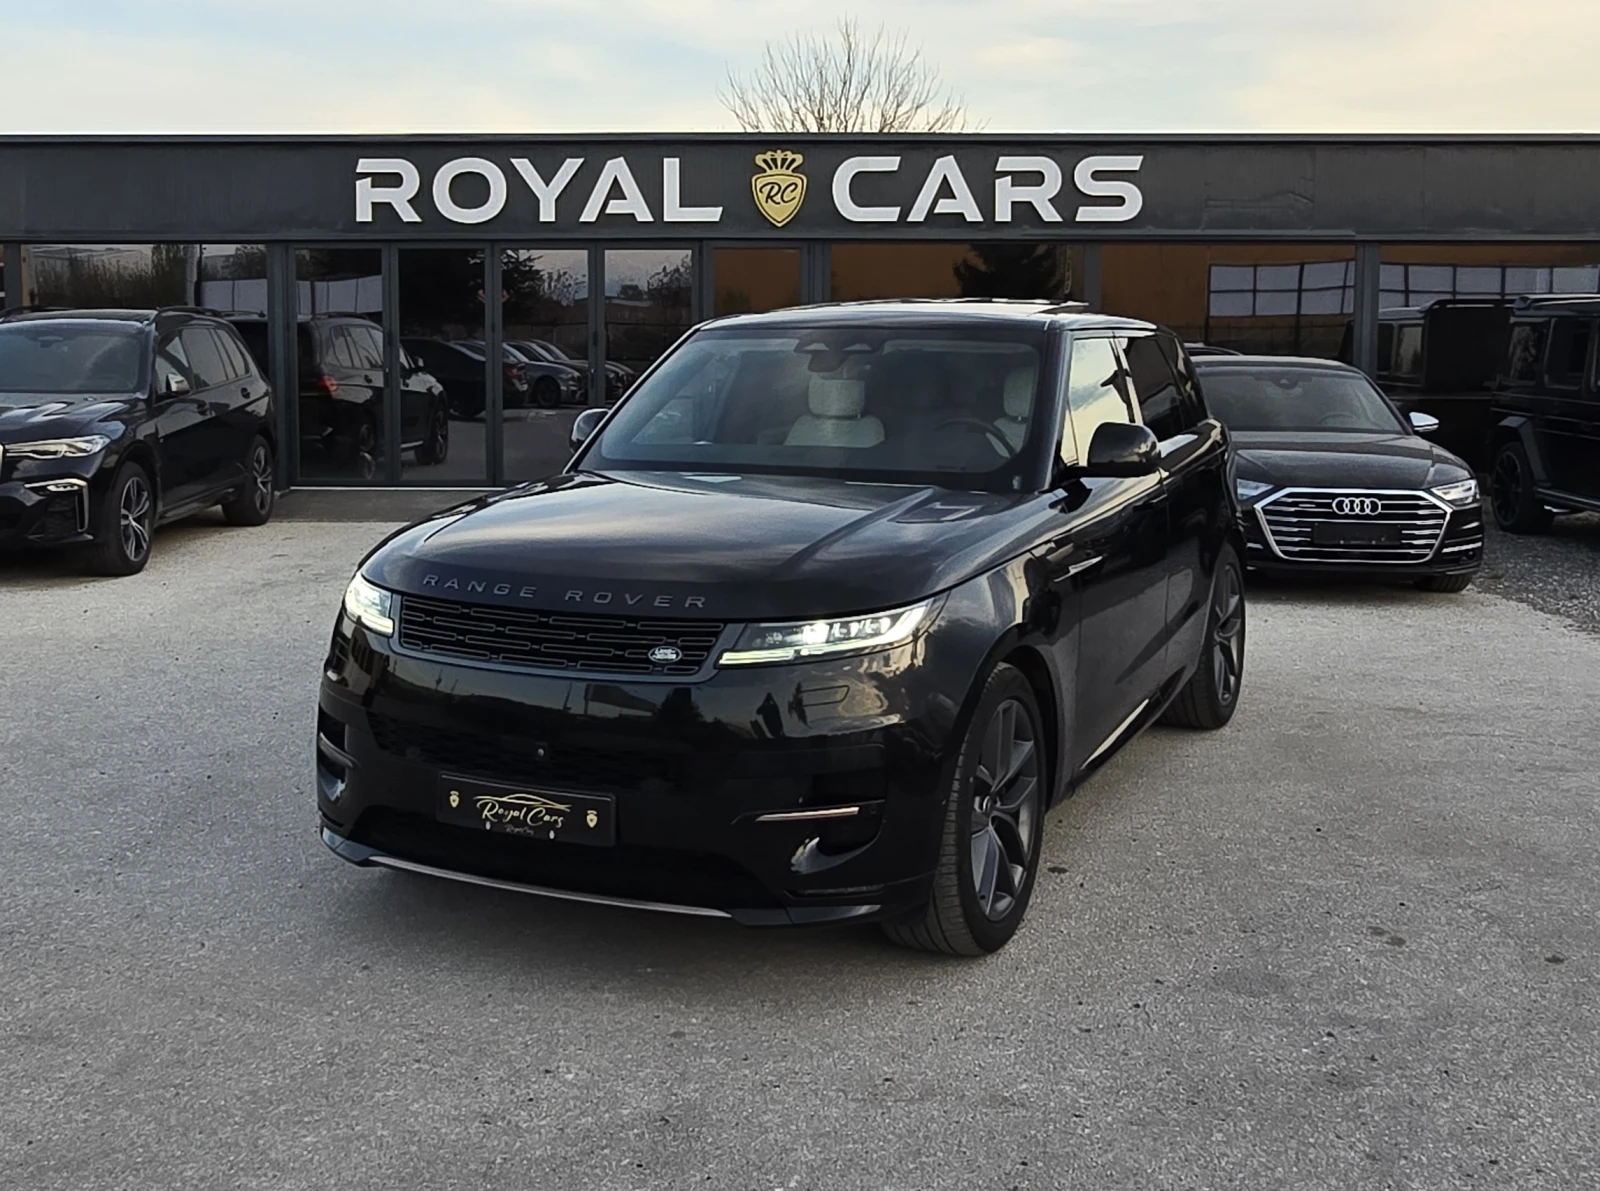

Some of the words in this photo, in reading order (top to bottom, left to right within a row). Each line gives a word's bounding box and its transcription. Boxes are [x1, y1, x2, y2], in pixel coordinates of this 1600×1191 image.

[355, 156, 723, 224] ROYAL
[831, 155, 1144, 222] CARS
[759, 182, 799, 205] RC
[423, 574, 537, 599] RANGE
[564, 589, 706, 609] ROVER
[476, 800, 527, 823] Royal
[526, 807, 564, 828] Cars
